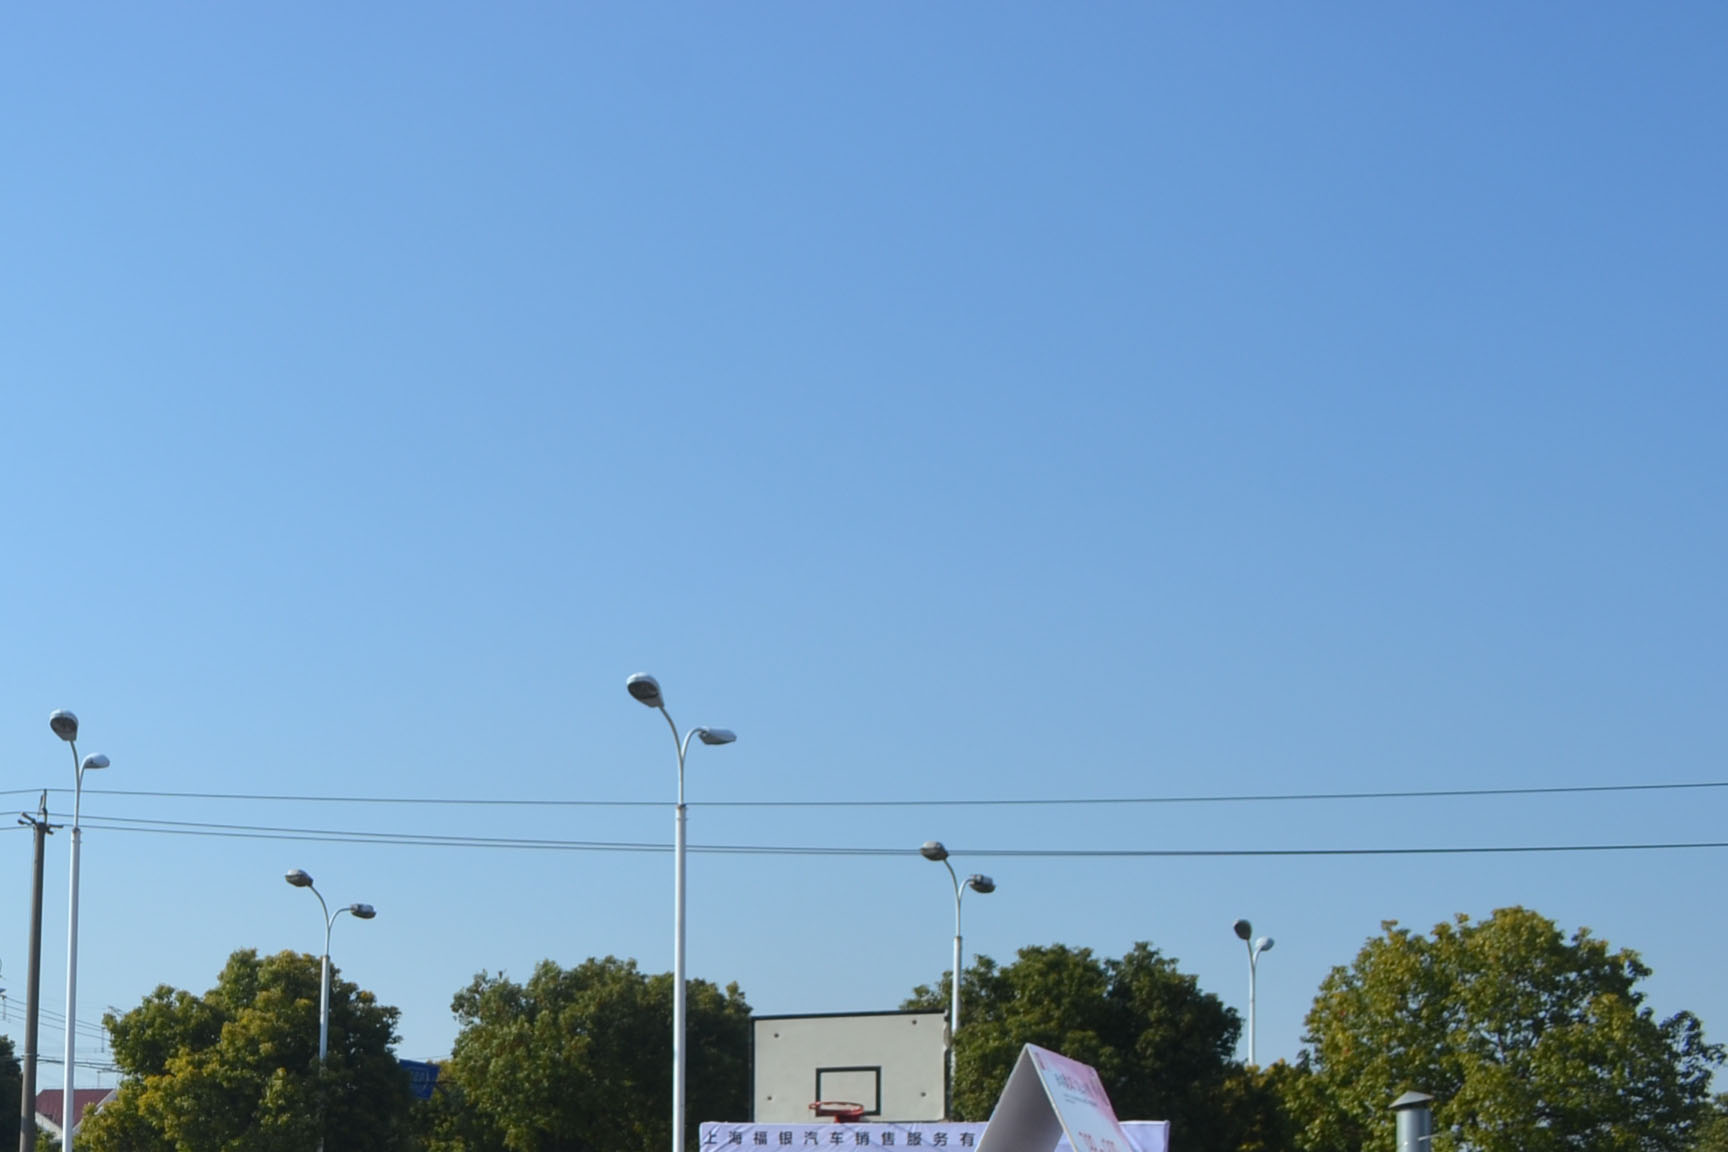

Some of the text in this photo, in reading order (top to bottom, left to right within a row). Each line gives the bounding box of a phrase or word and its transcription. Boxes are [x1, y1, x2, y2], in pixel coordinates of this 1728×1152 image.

[703, 1130, 976, 1147] 上海福银汽车销售服务有
